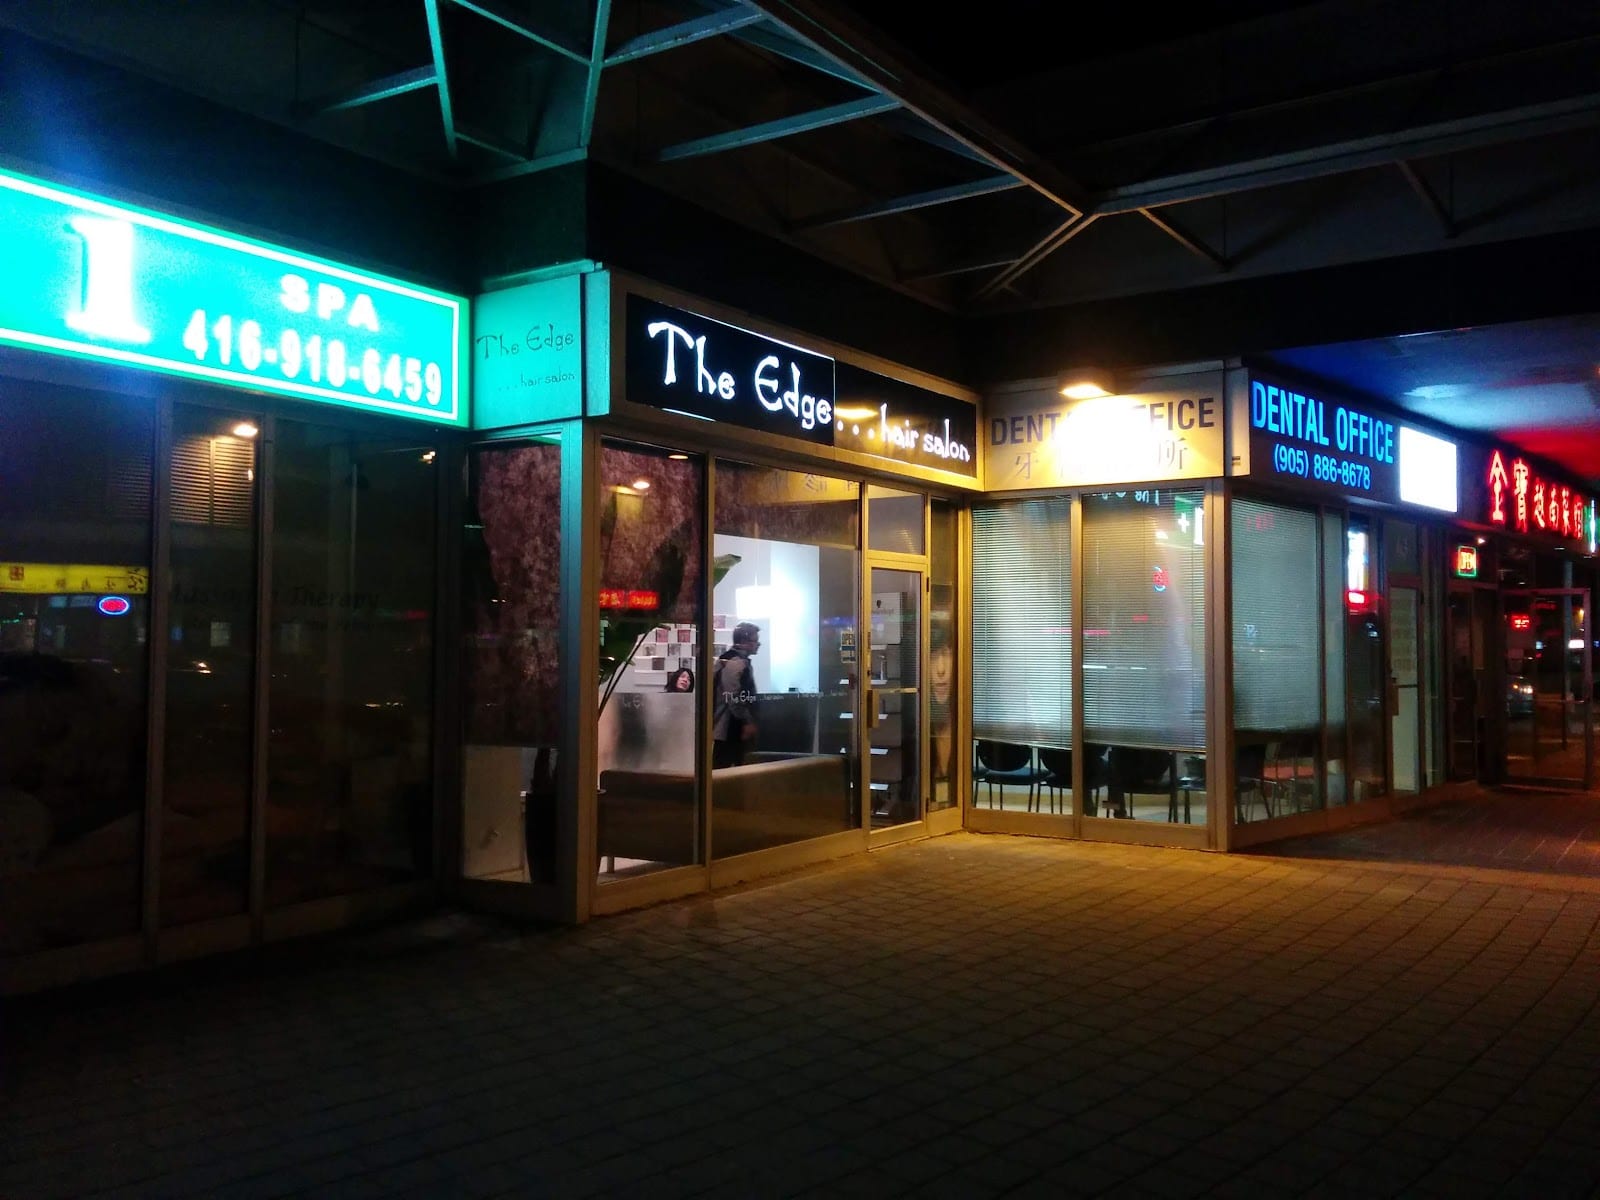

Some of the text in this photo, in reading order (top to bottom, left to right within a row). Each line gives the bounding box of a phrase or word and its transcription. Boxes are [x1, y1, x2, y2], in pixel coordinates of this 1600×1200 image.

[279, 273, 380, 332] SPA
[476, 323, 575, 360] The Edge
[544, 365, 576, 385] salon
[648, 321, 833, 430] The Edge
[922, 418, 970, 463] salon
[1252, 380, 1394, 464] DENTAL OFFICE
[1274, 443, 1371, 490] (905) 886-8678
